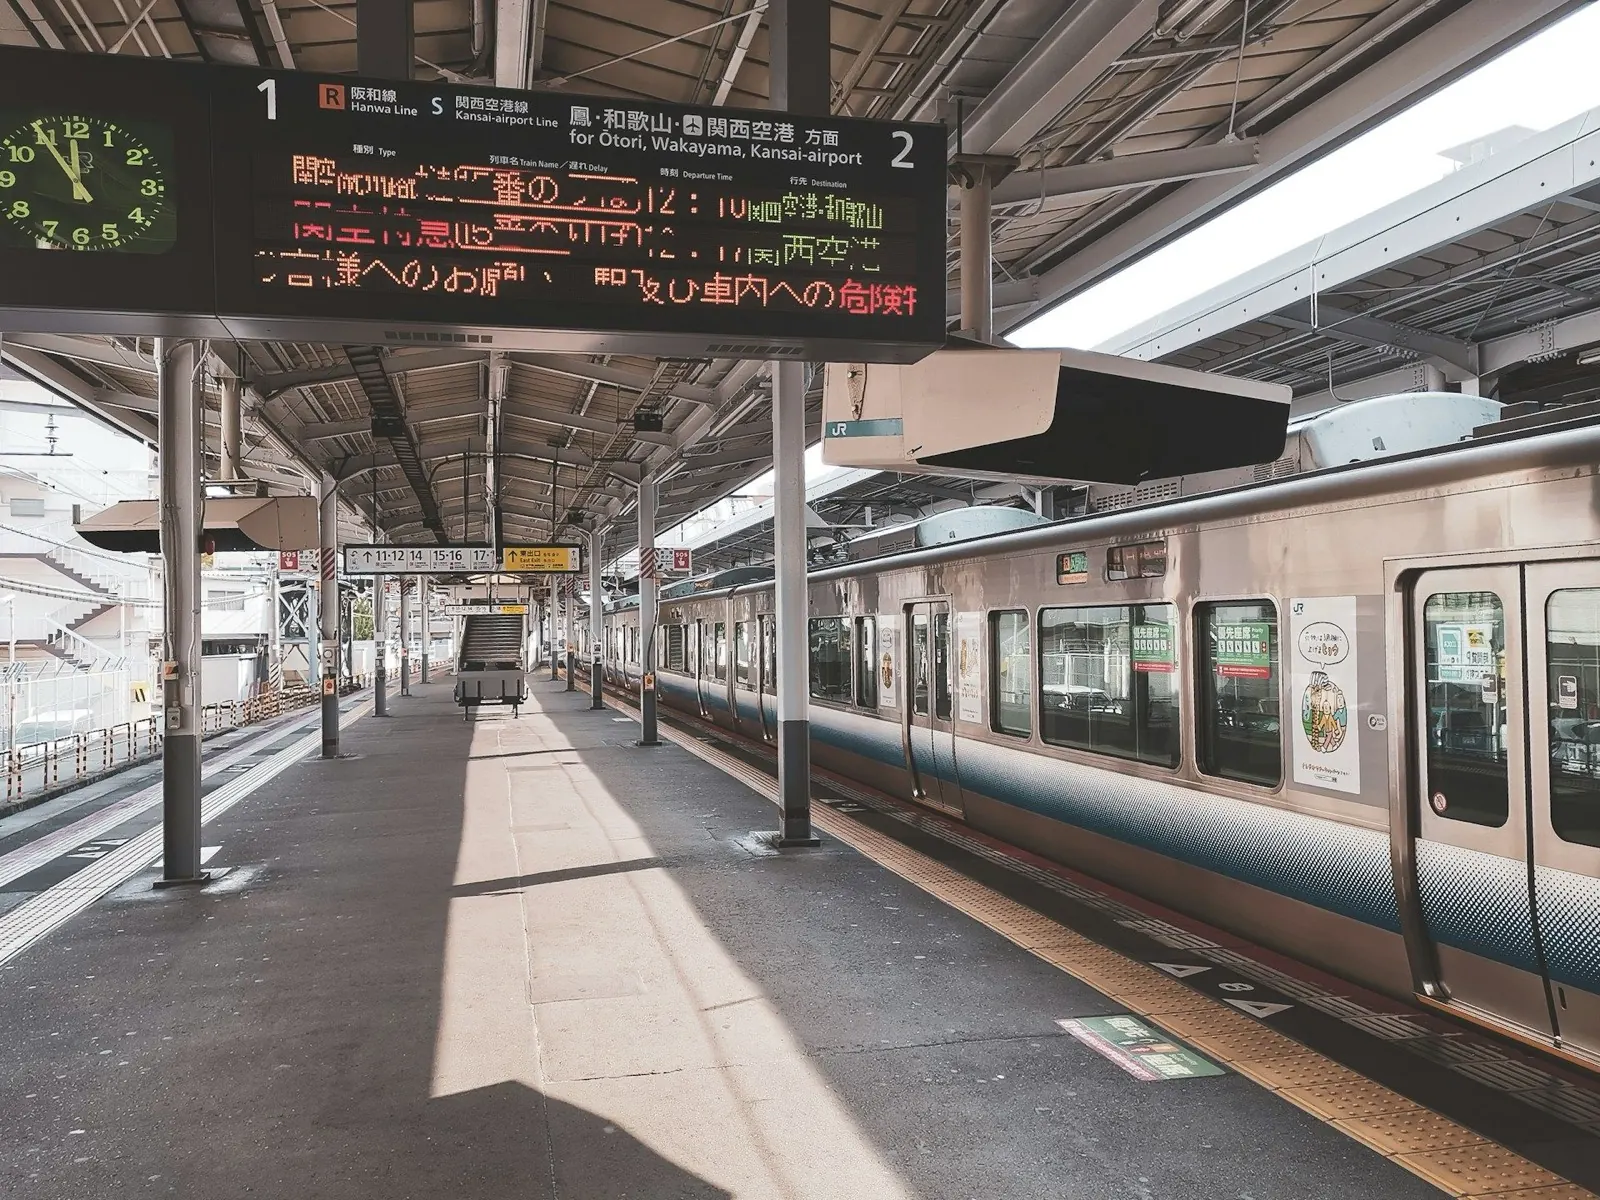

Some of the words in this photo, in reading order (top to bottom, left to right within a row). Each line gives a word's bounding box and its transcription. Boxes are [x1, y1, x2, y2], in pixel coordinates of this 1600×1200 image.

[256, 79, 277, 120] 1
[325, 87, 340, 105] R
[350, 86, 397, 103] 阪和線
[351, 101, 391, 116] Hanwa
[394, 103, 418, 117] Line
[431, 96, 443, 116] S
[455, 95, 529, 114] 関西空港線
[455, 109, 533, 127] Kansai-airport
[535, 117, 559, 128] Line
[63, 121, 90, 139] 12
[707, 117, 795, 144] 関西空港
[805, 128, 840, 147] 方面
[103, 131, 114, 147] 1
[9, 145, 35, 163] 10
[353, 144, 374, 156] 種別
[378, 147, 396, 158] Type
[569, 129, 594, 147] for
[599, 130, 647, 154] Ōtori,
[652, 136, 747, 161] Wakayama,
[750, 142, 863, 167] Kansai-airport
[890, 130, 915, 169] 2
[126, 149, 144, 166] 2
[489, 154, 519, 168] 列車名
[519, 158, 537, 169] Train
[538, 160, 559, 170] Name
[588, 163, 609, 174] Delay
[0, 170, 16, 188] 9
[660, 167, 679, 178] 時刻
[682, 170, 717, 181] Departure
[716, 172, 734, 182] Time
[789, 176, 809, 187] 行先
[811, 178, 848, 190] Destination
[140, 179, 158, 196] 3
[12, 201, 30, 218] 8
[127, 207, 145, 224] 4
[42, 220, 59, 238] 7
[72, 228, 90, 245] 6
[101, 223, 119, 240] 5
[832, 422, 847, 436] JR
[409, 550, 423, 561] 14
[1293, 602, 1304, 613] JR
[1217, 626, 1251, 640] 優先座席
